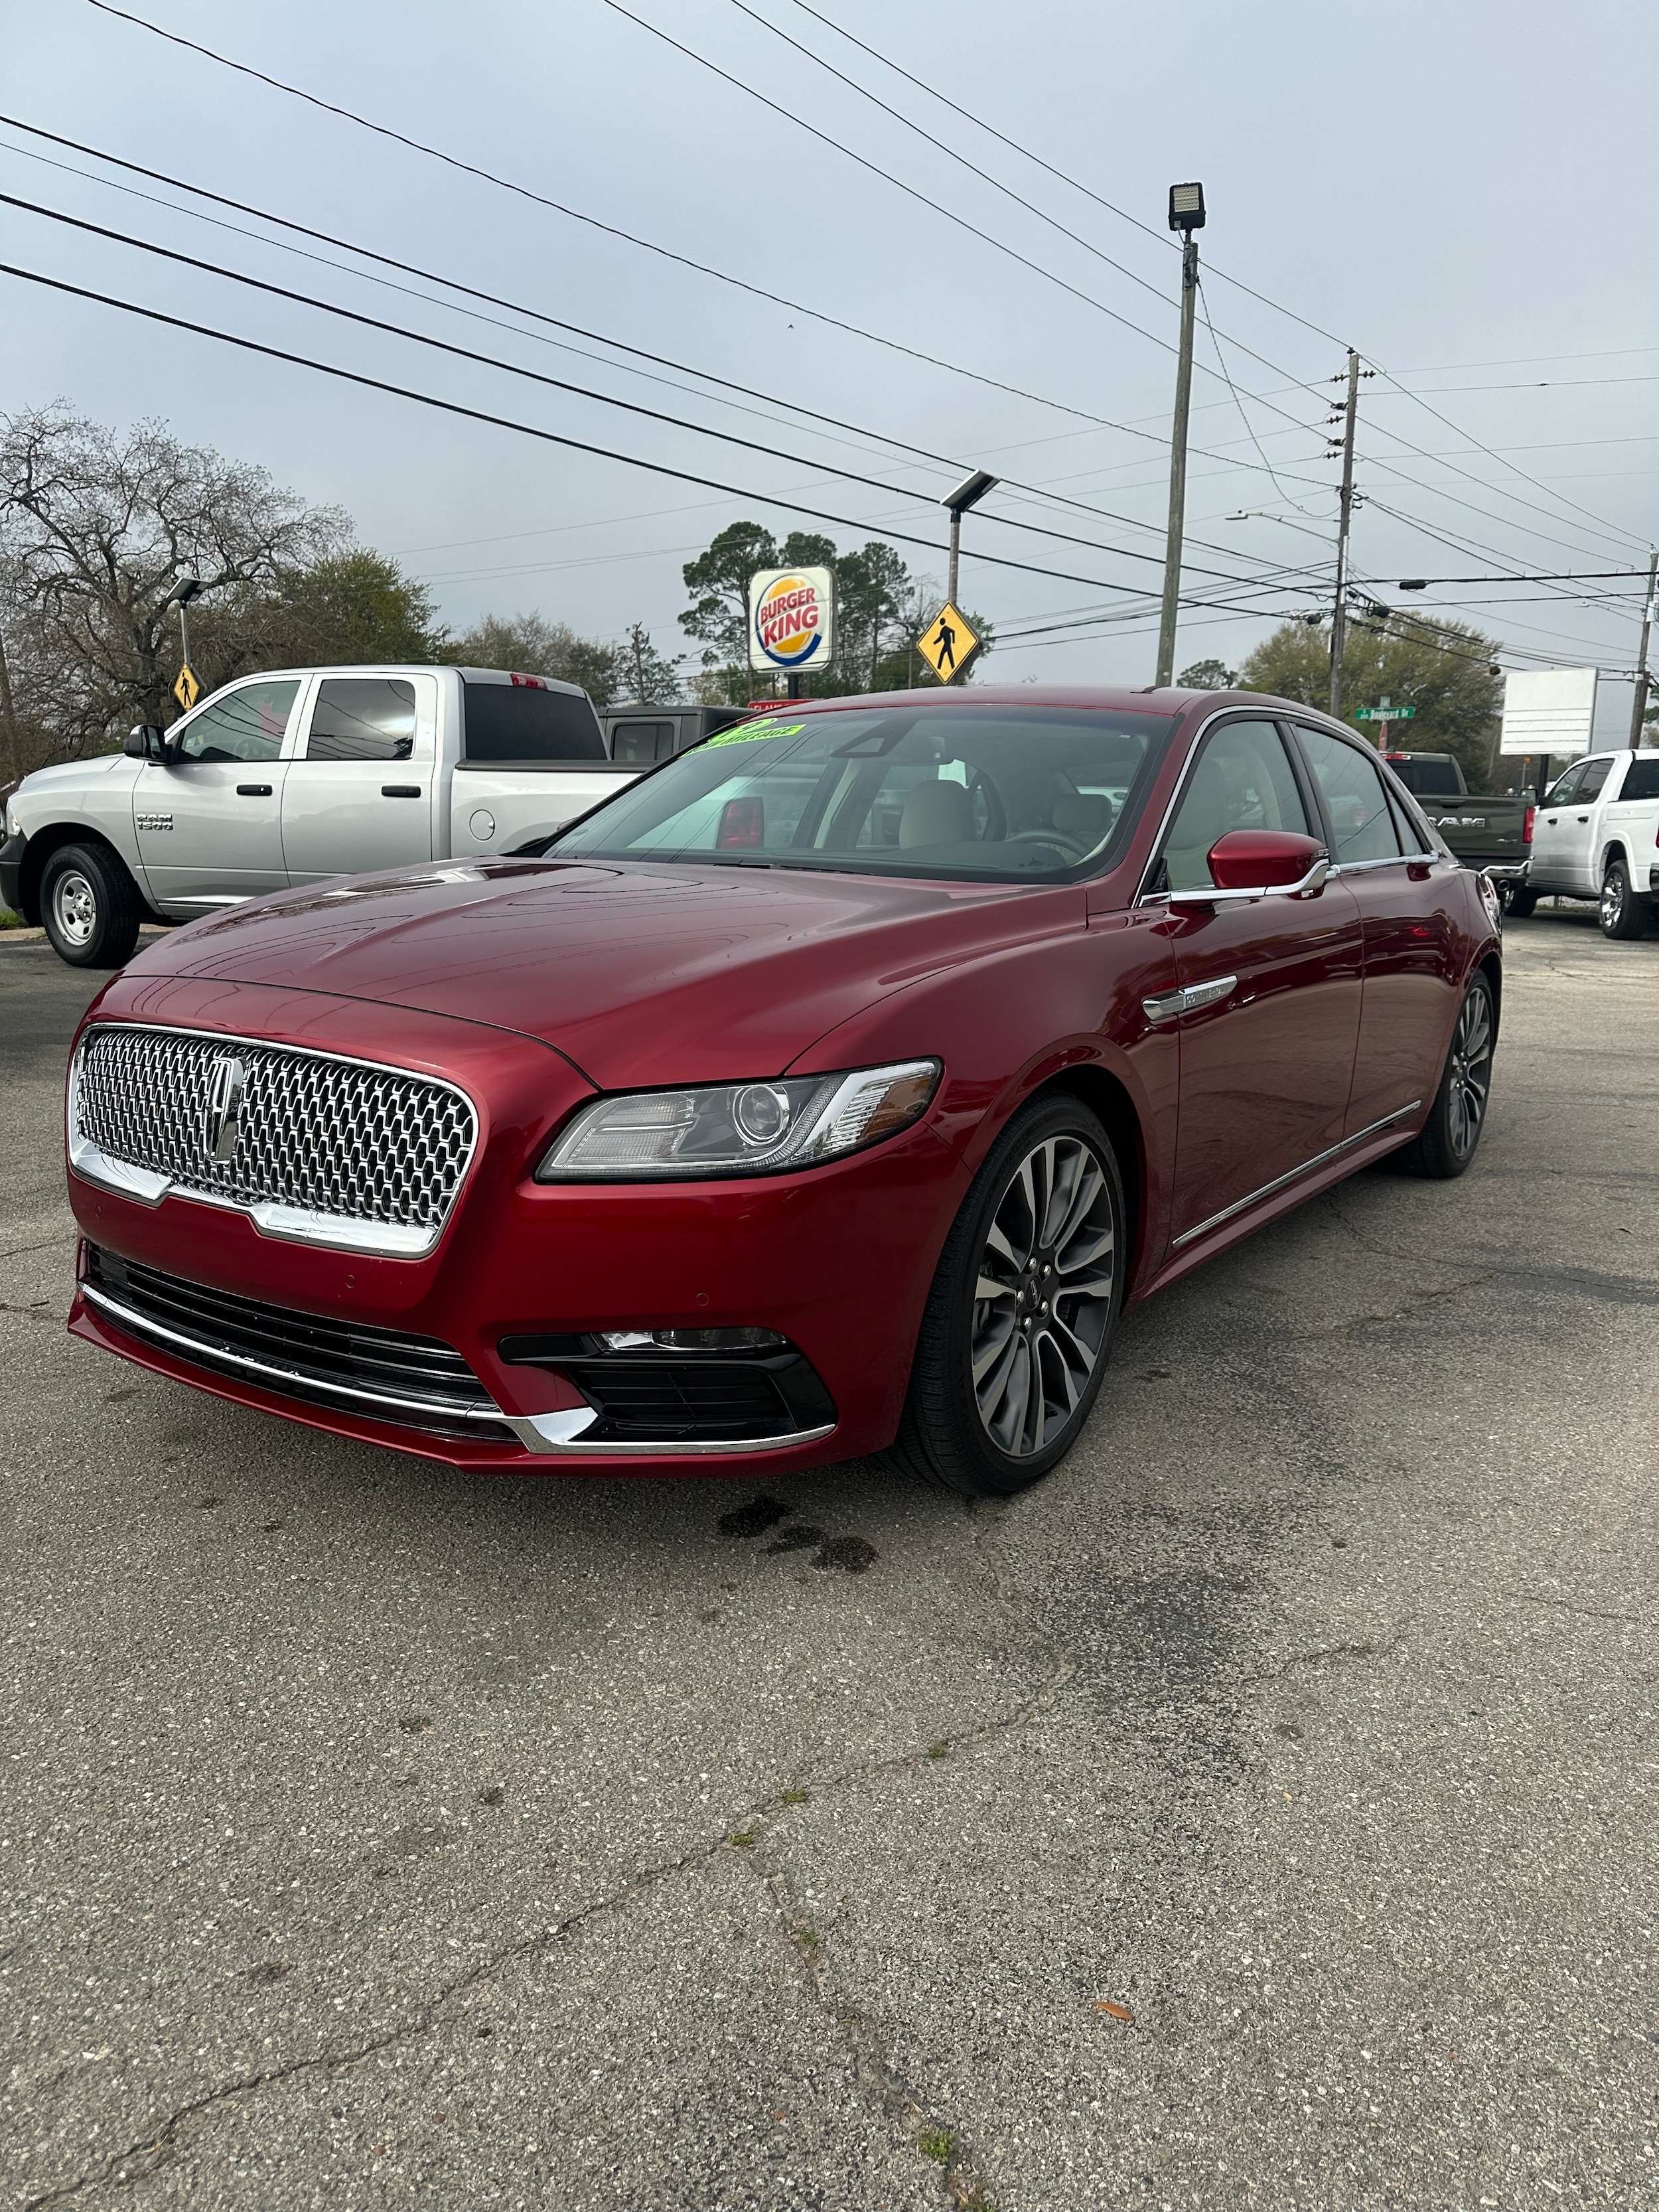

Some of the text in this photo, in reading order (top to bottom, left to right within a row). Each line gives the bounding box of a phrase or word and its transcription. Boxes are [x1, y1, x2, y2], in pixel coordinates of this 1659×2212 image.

[760, 587, 816, 626] BURGER
[764, 605, 819, 648] KING
[1370, 708, 1409, 719] Boulevard Dr
[719, 726, 799, 746] MILEAGE
[137, 814, 173, 822] RAM
